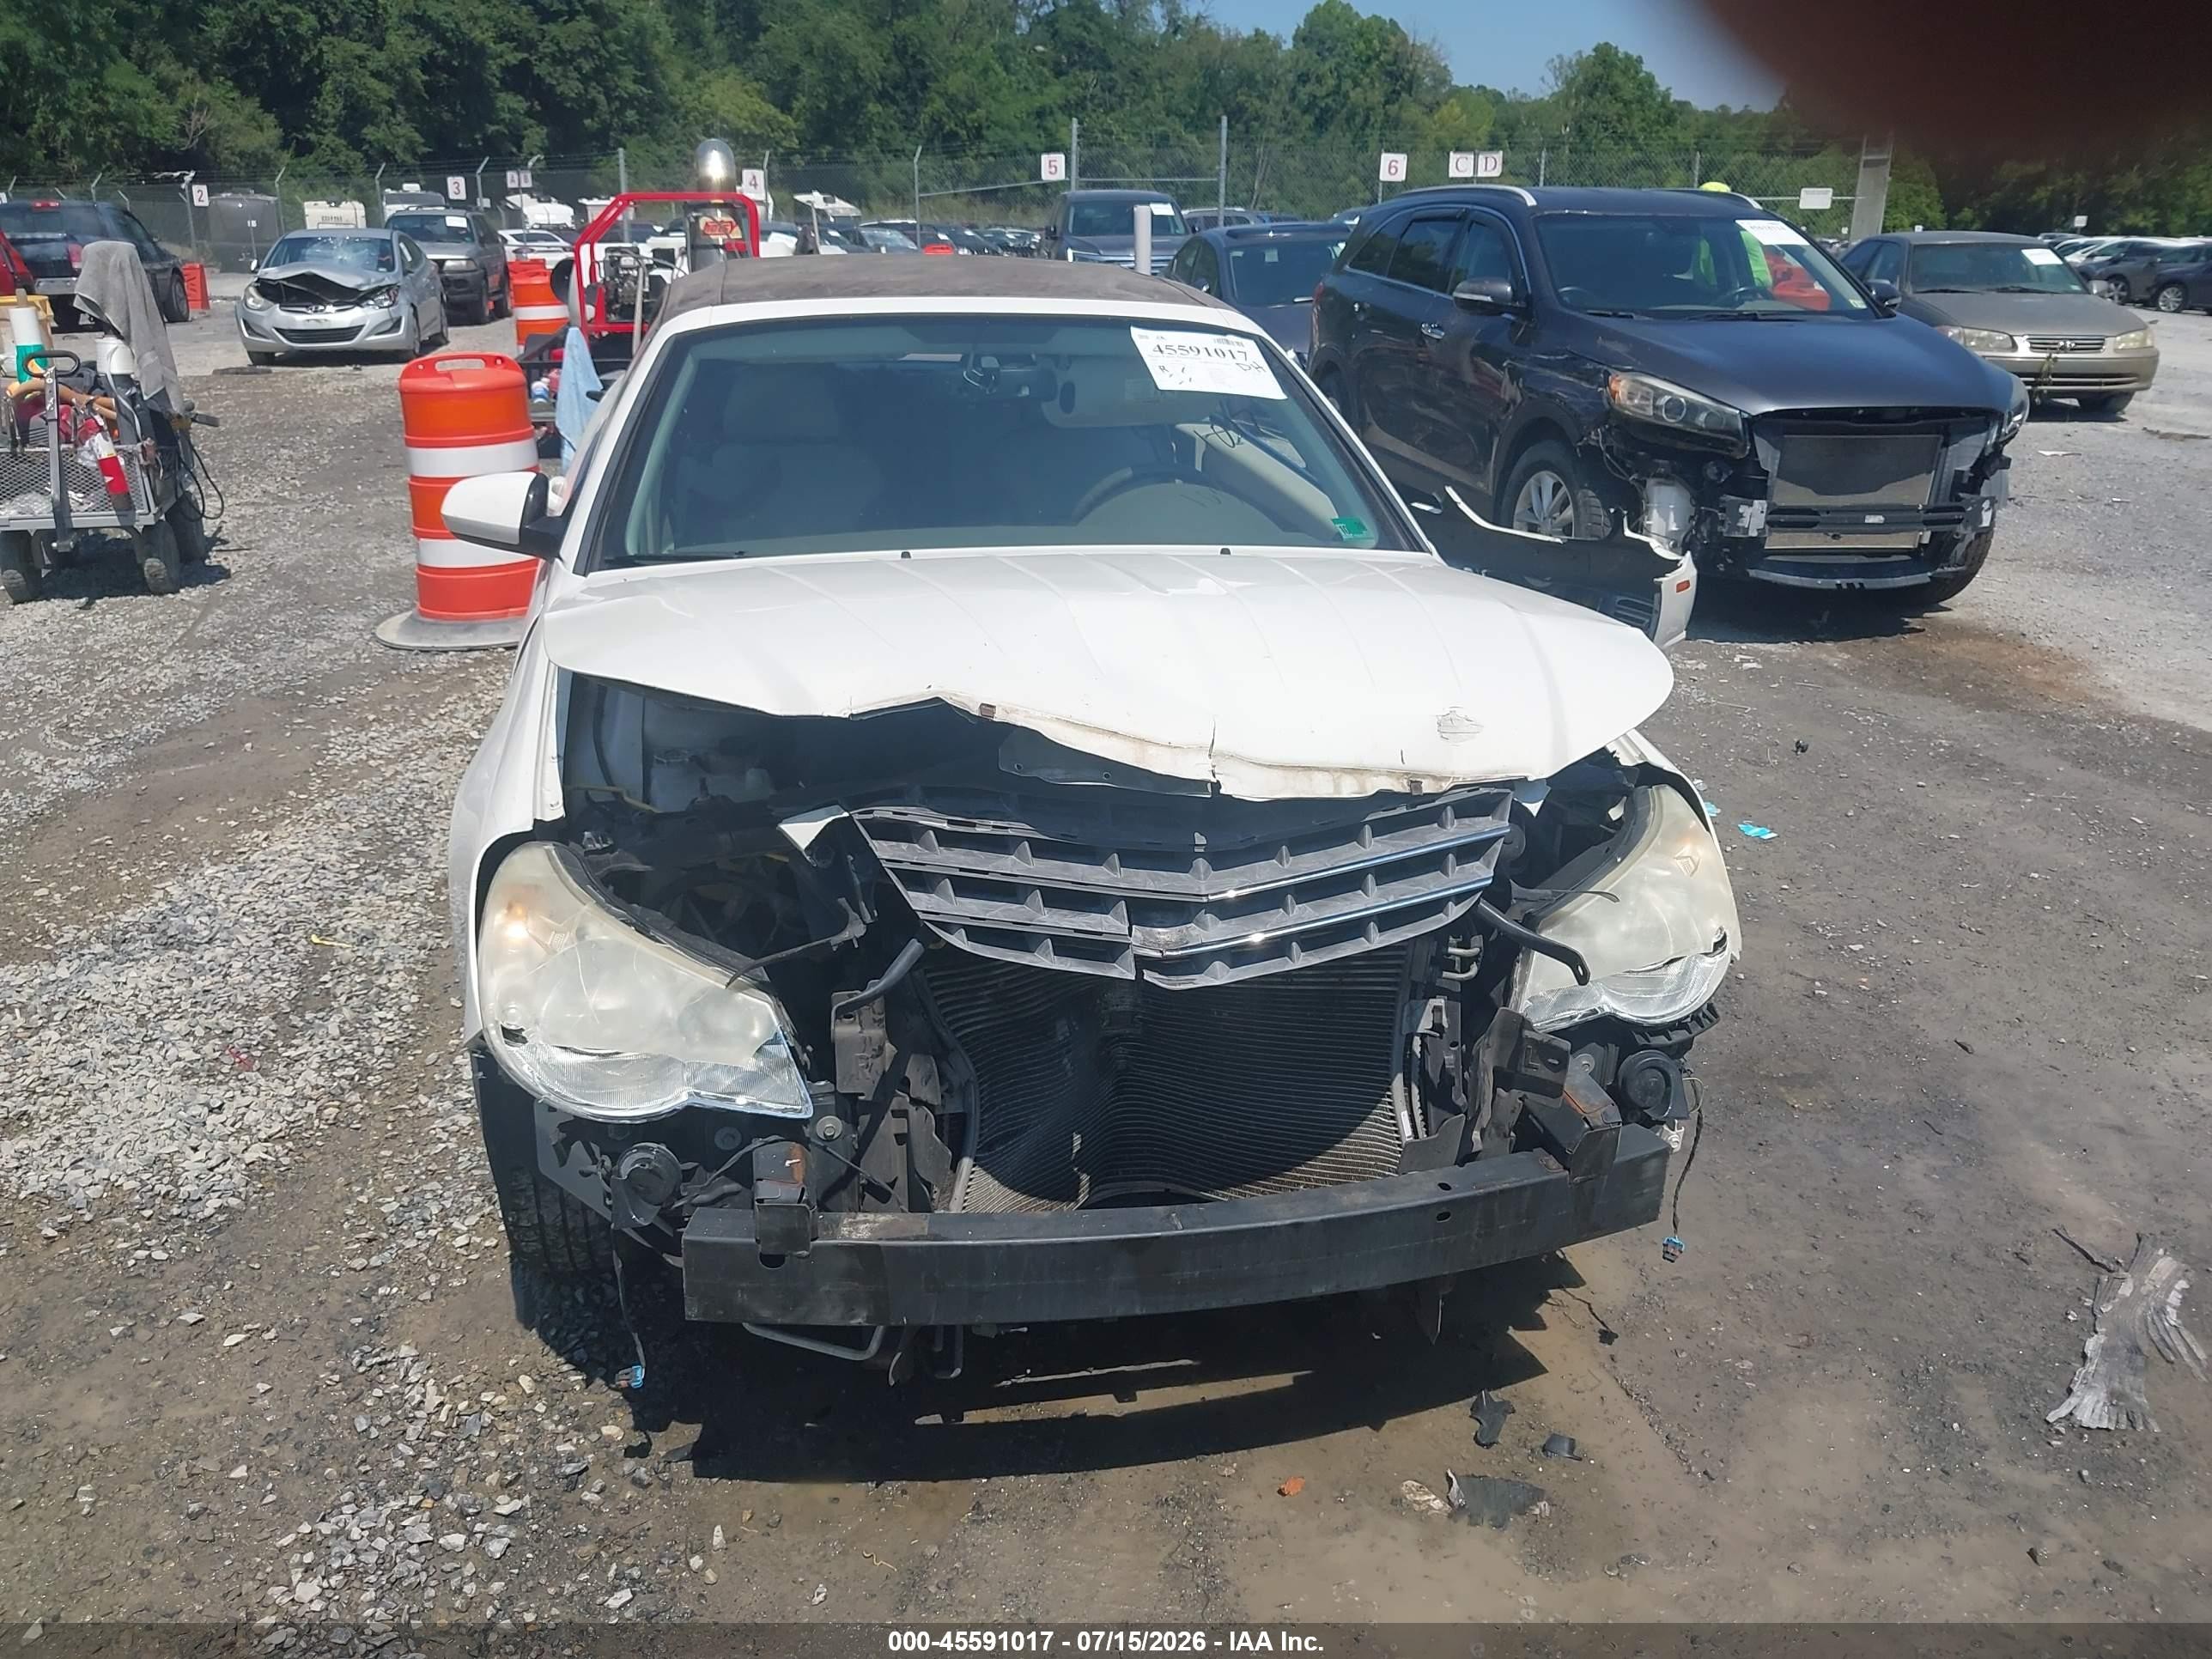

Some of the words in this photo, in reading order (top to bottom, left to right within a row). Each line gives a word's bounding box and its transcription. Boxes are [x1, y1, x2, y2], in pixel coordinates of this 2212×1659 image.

[1048, 160, 1058, 176] 5
[1388, 160, 1399, 176] 6
[1455, 156, 1468, 173] C
[1484, 156, 1498, 173] D
[453, 181, 461, 196] 3
[749, 174, 759, 190] 4
[197, 189, 204, 203] 2
[1152, 343, 1249, 362] 45591017
